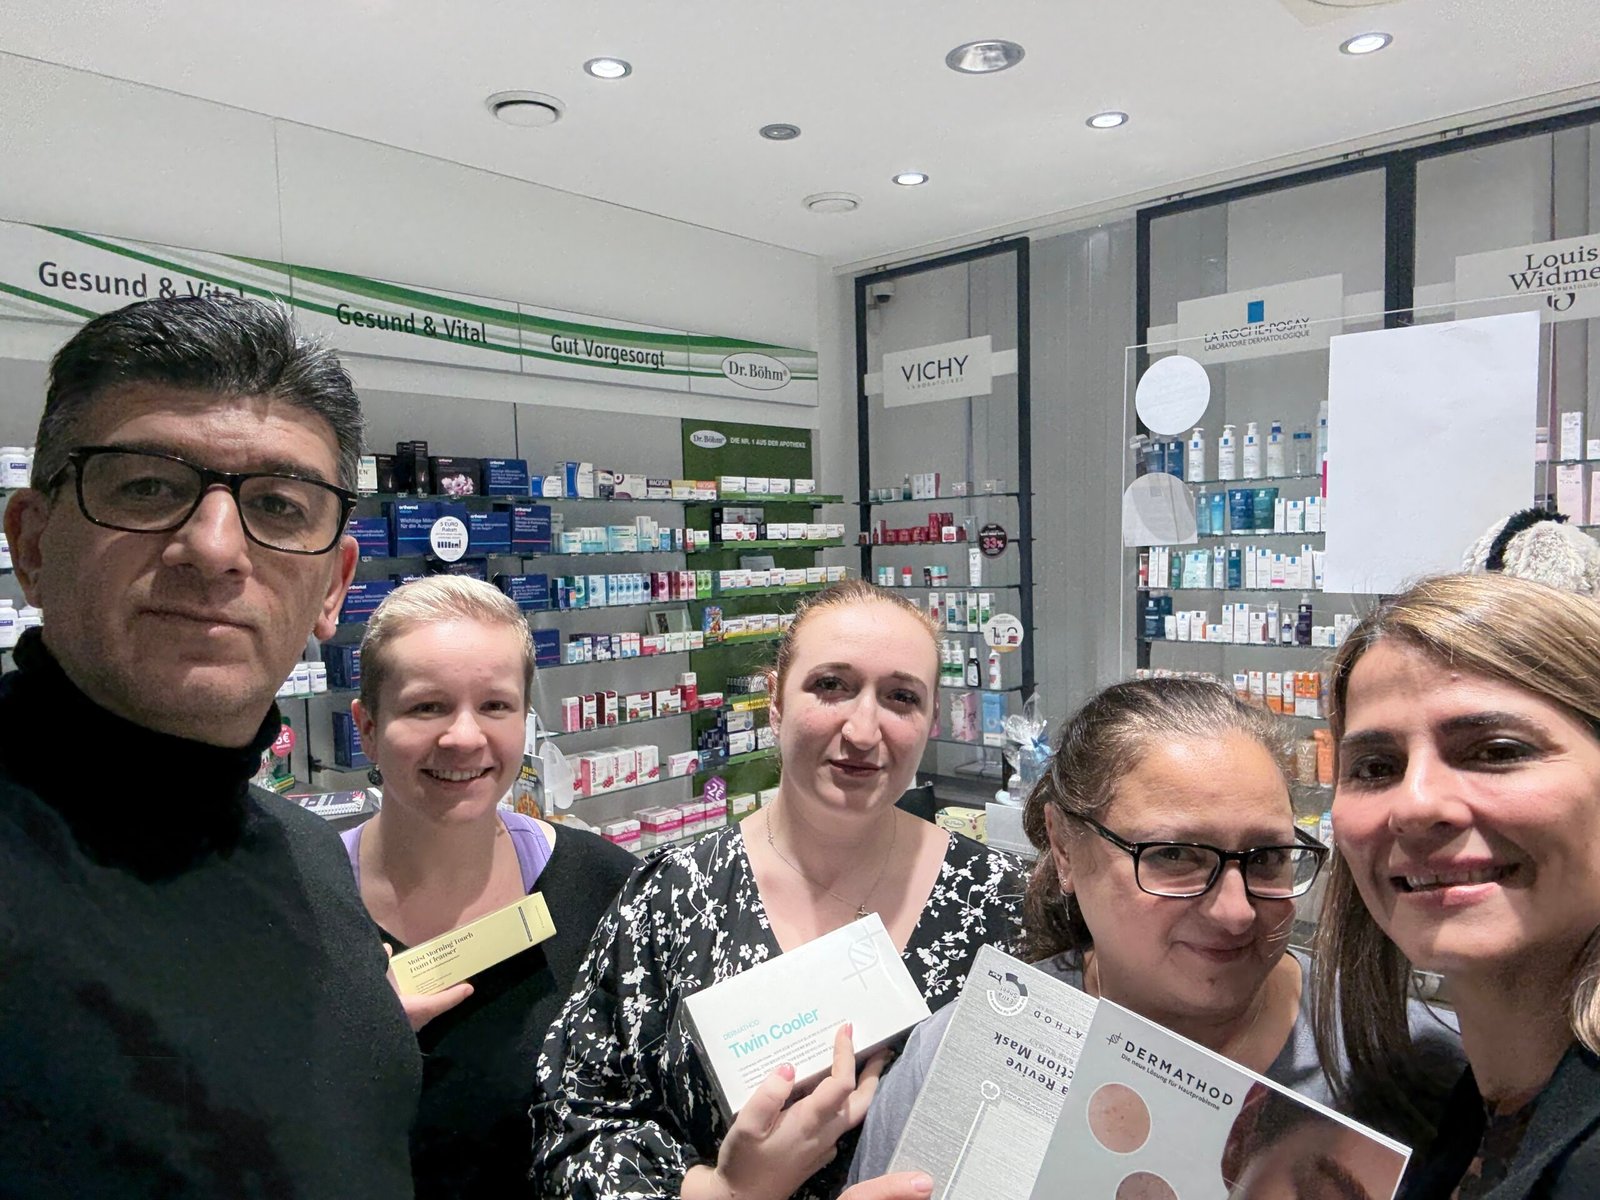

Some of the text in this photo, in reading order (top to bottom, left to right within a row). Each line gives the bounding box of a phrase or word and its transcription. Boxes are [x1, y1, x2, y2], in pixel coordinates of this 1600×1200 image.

[1526, 246, 1599, 271] Louis
[38, 261, 147, 298] Gesund
[159, 276, 177, 299] &
[336, 303, 487, 344] Gesund & Vital
[1204, 317, 1310, 344] LA ROCHE-POSAY
[551, 334, 665, 370] Gut Vorgesorgt
[1204, 339, 1247, 352] LABORATOIRE
[729, 361, 747, 377] Dr.
[901, 354, 969, 383] VICHY
[728, 1033, 769, 1058] Twin
[769, 1007, 819, 1041] Cooler
[994, 1031, 1032, 1059] Mask
[1006, 1055, 1056, 1090] Revive
[1121, 1053, 1220, 1111] Die neue Lösung für Hautprobleme
[1124, 1040, 1233, 1106] DERMATHOD
